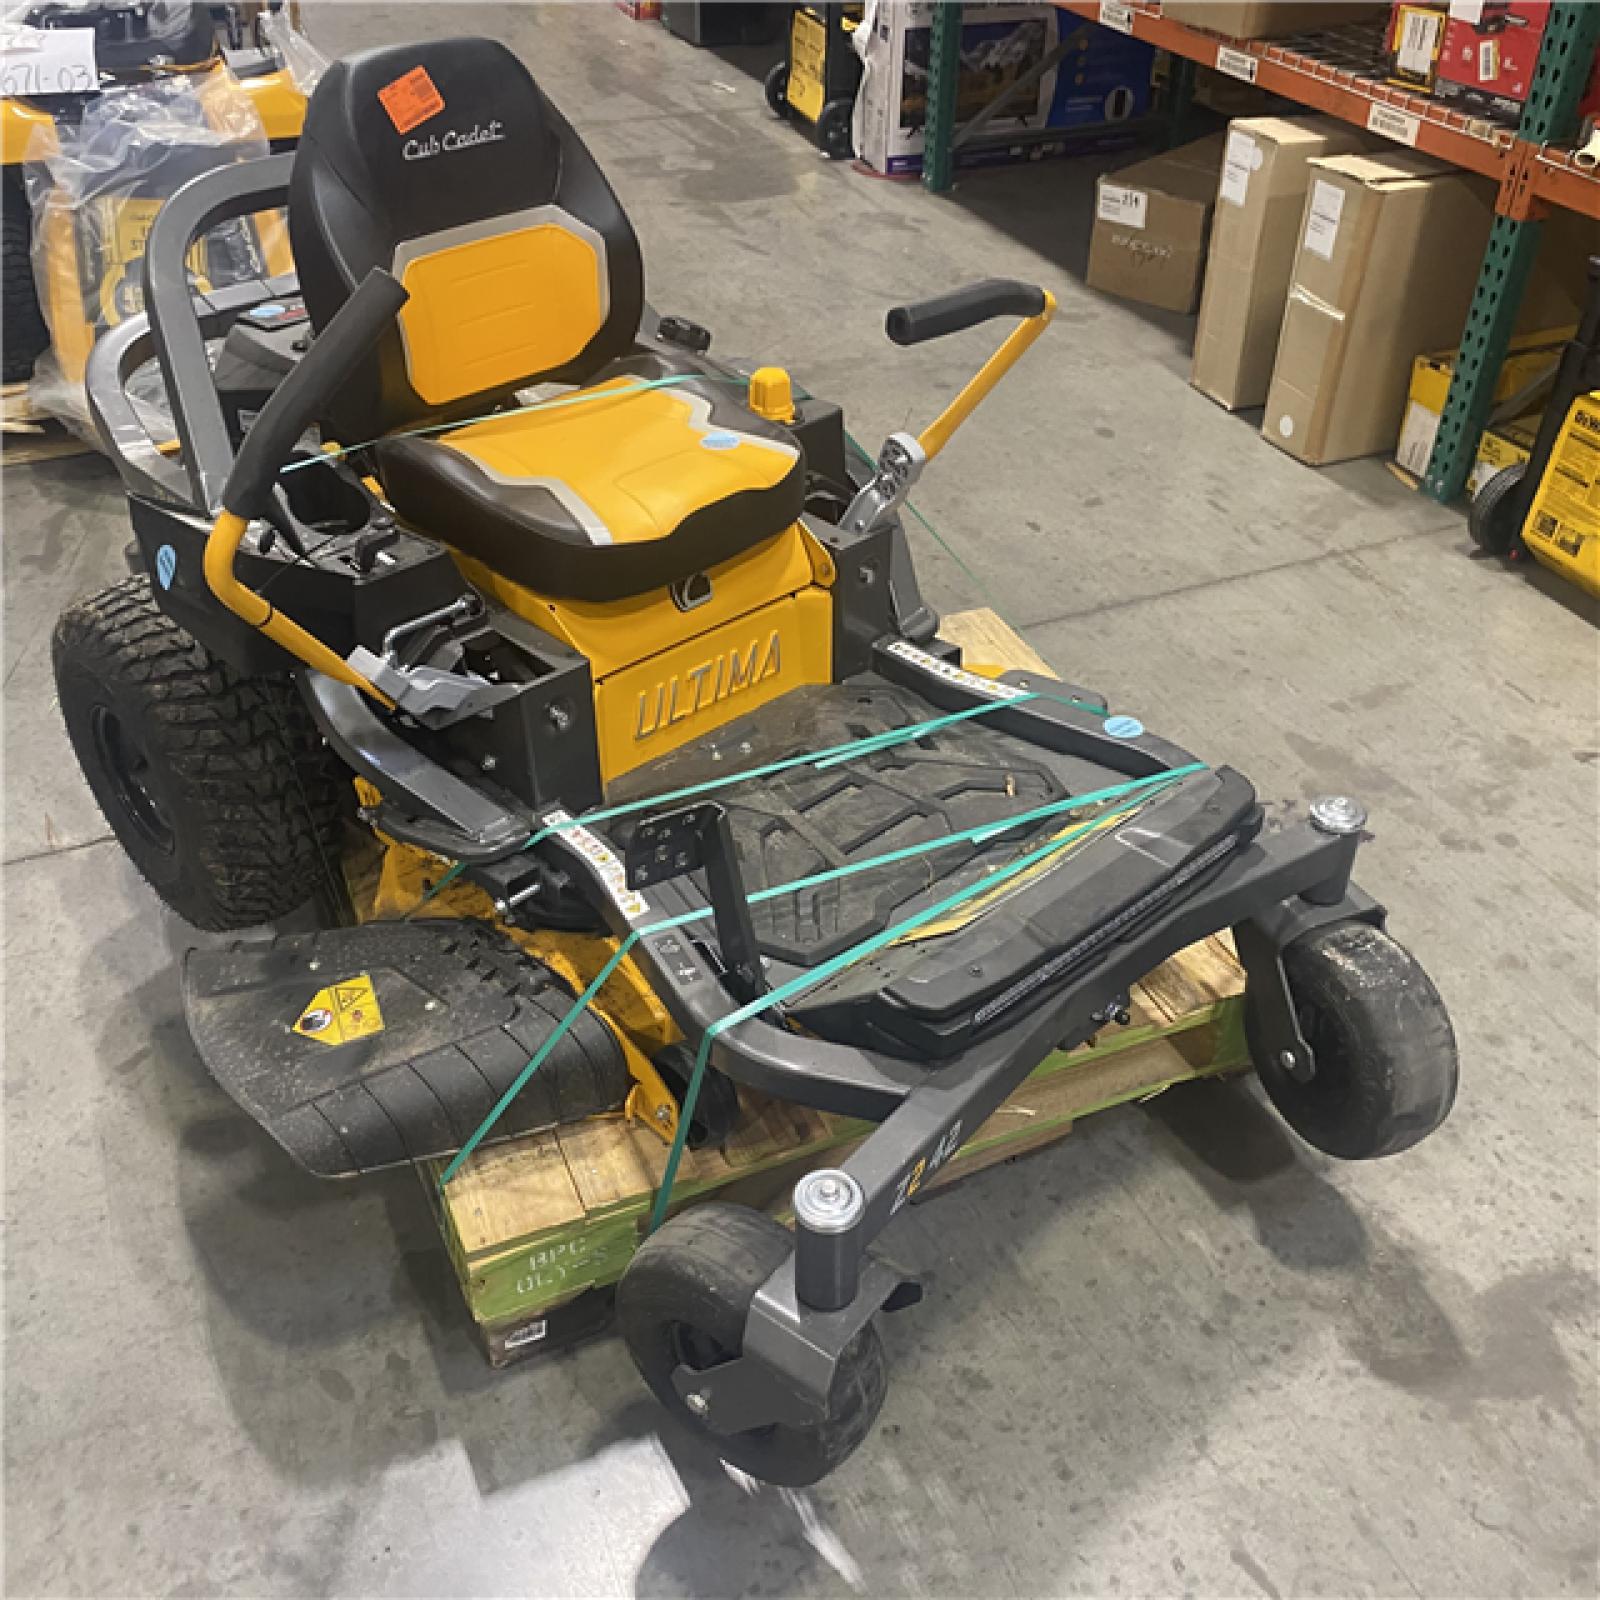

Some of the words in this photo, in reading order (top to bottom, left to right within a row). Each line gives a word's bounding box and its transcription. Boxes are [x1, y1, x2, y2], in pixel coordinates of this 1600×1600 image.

[402, 134, 441, 161] Cub
[442, 120, 506, 151] Cadet
[635, 629, 781, 743] ULTIMA
